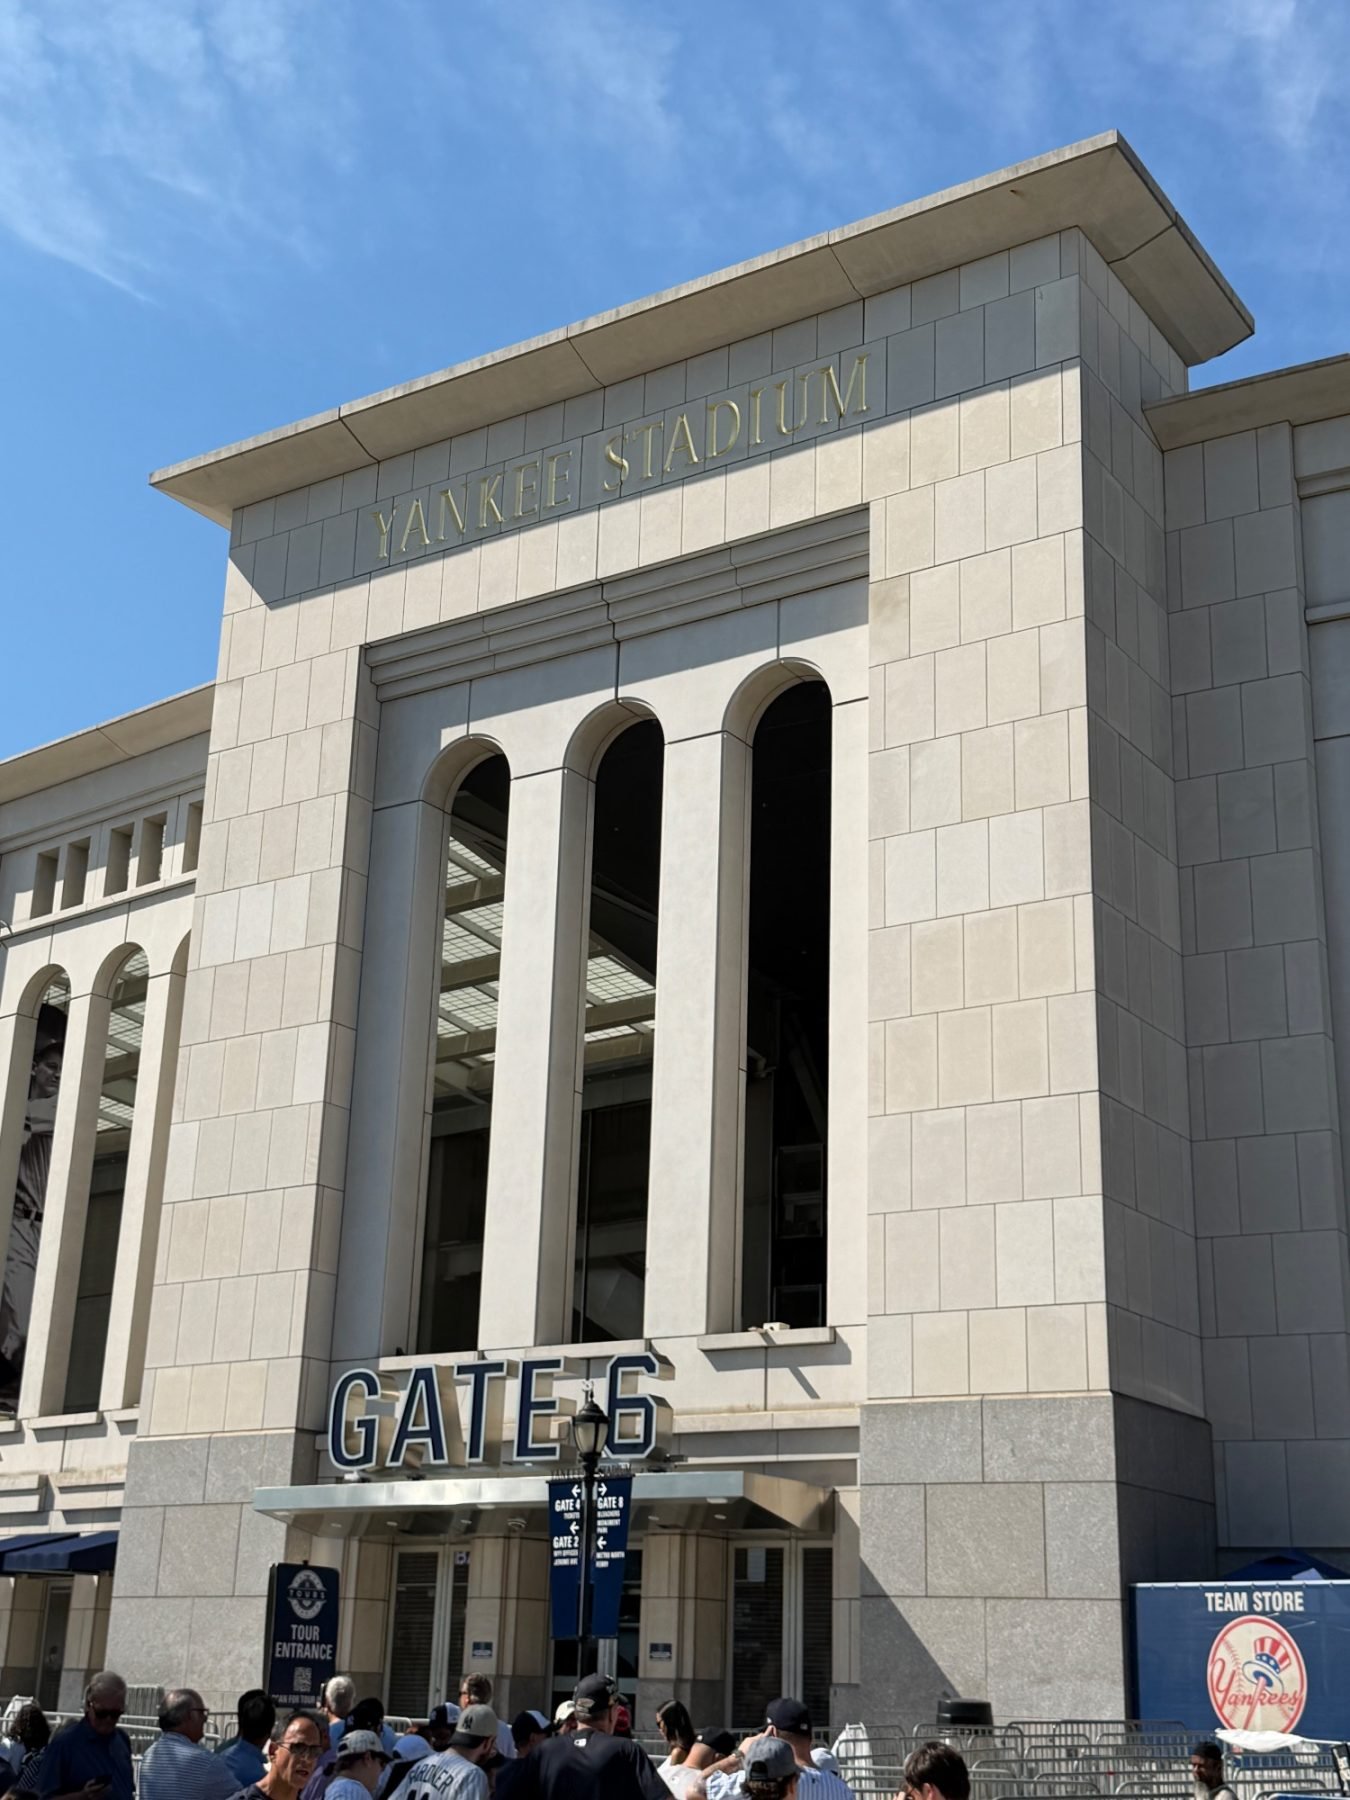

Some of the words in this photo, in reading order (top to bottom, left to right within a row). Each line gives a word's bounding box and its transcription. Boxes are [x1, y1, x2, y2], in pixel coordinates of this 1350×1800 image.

[370, 449, 573, 560] YANKEE
[602, 352, 870, 493] STADIUM
[328, 1355, 567, 1472] GATE
[604, 1351, 660, 1460] 6
[555, 1499, 574, 1512] GATE
[597, 1497, 617, 1509] GATE
[553, 1536, 572, 1548] GATE
[574, 1535, 579, 1548] 2
[289, 1589, 325, 1599] TOURS
[1204, 1592, 1249, 1612] TEAM
[1252, 1591, 1305, 1612] STORE
[290, 1624, 320, 1641] TOUR
[275, 1642, 333, 1660] ENTRANCE
[1211, 1658, 1300, 1712] Yankees
